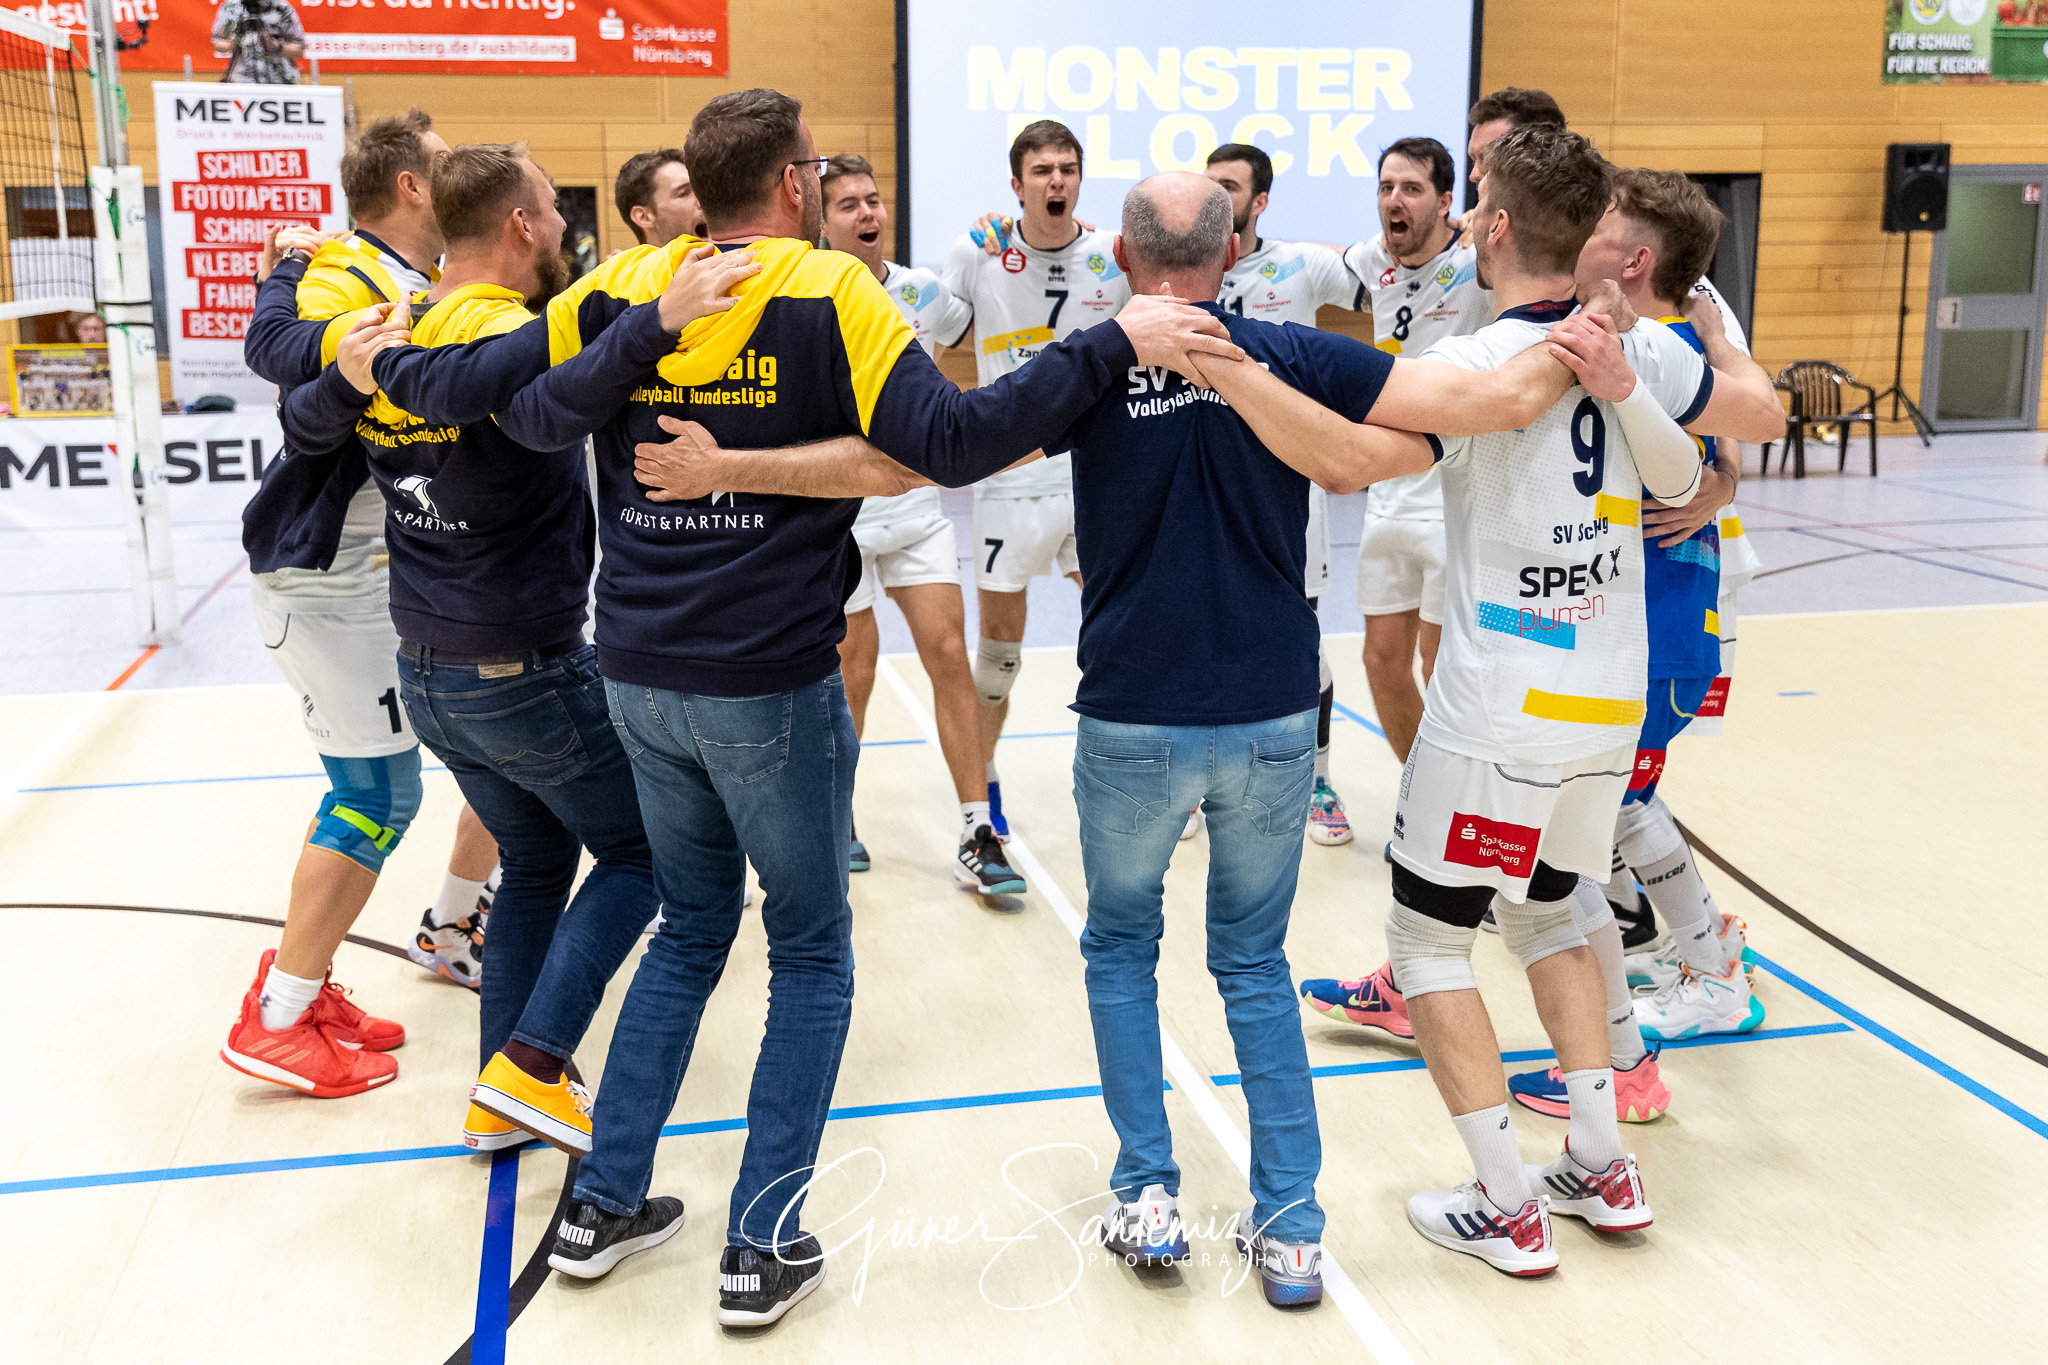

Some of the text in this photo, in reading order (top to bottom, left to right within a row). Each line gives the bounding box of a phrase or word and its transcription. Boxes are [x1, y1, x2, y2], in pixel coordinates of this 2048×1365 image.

[632, 23, 717, 44] Sparkasse
[1889, 31, 1916, 50] FÜR
[633, 46, 712, 68] Nürnberg
[1887, 54, 1915, 73] FÜR
[1917, 57, 1938, 73] DIE
[967, 47, 1413, 112] MONSTER
[175, 99, 325, 125] MEYSEL
[202, 152, 303, 180] SCHILDER
[181, 184, 323, 213] FOTOTAPETEN
[191, 251, 263, 278] KLEBE
[205, 282, 257, 309] FAHR
[1045, 289, 1069, 330] 7
[1392, 305, 1414, 342] 8
[1128, 366, 1168, 395] SV
[630, 385, 685, 406] lleyball
[1571, 396, 1606, 498] 9
[0, 439, 262, 489] MESE
[403, 512, 471, 532] PARTNER
[620, 506, 765, 530] FÜRST & PARTNER
[1553, 523, 1573, 544] SV
[984, 537, 1004, 574] 7
[1518, 553, 1604, 598] SPEK
